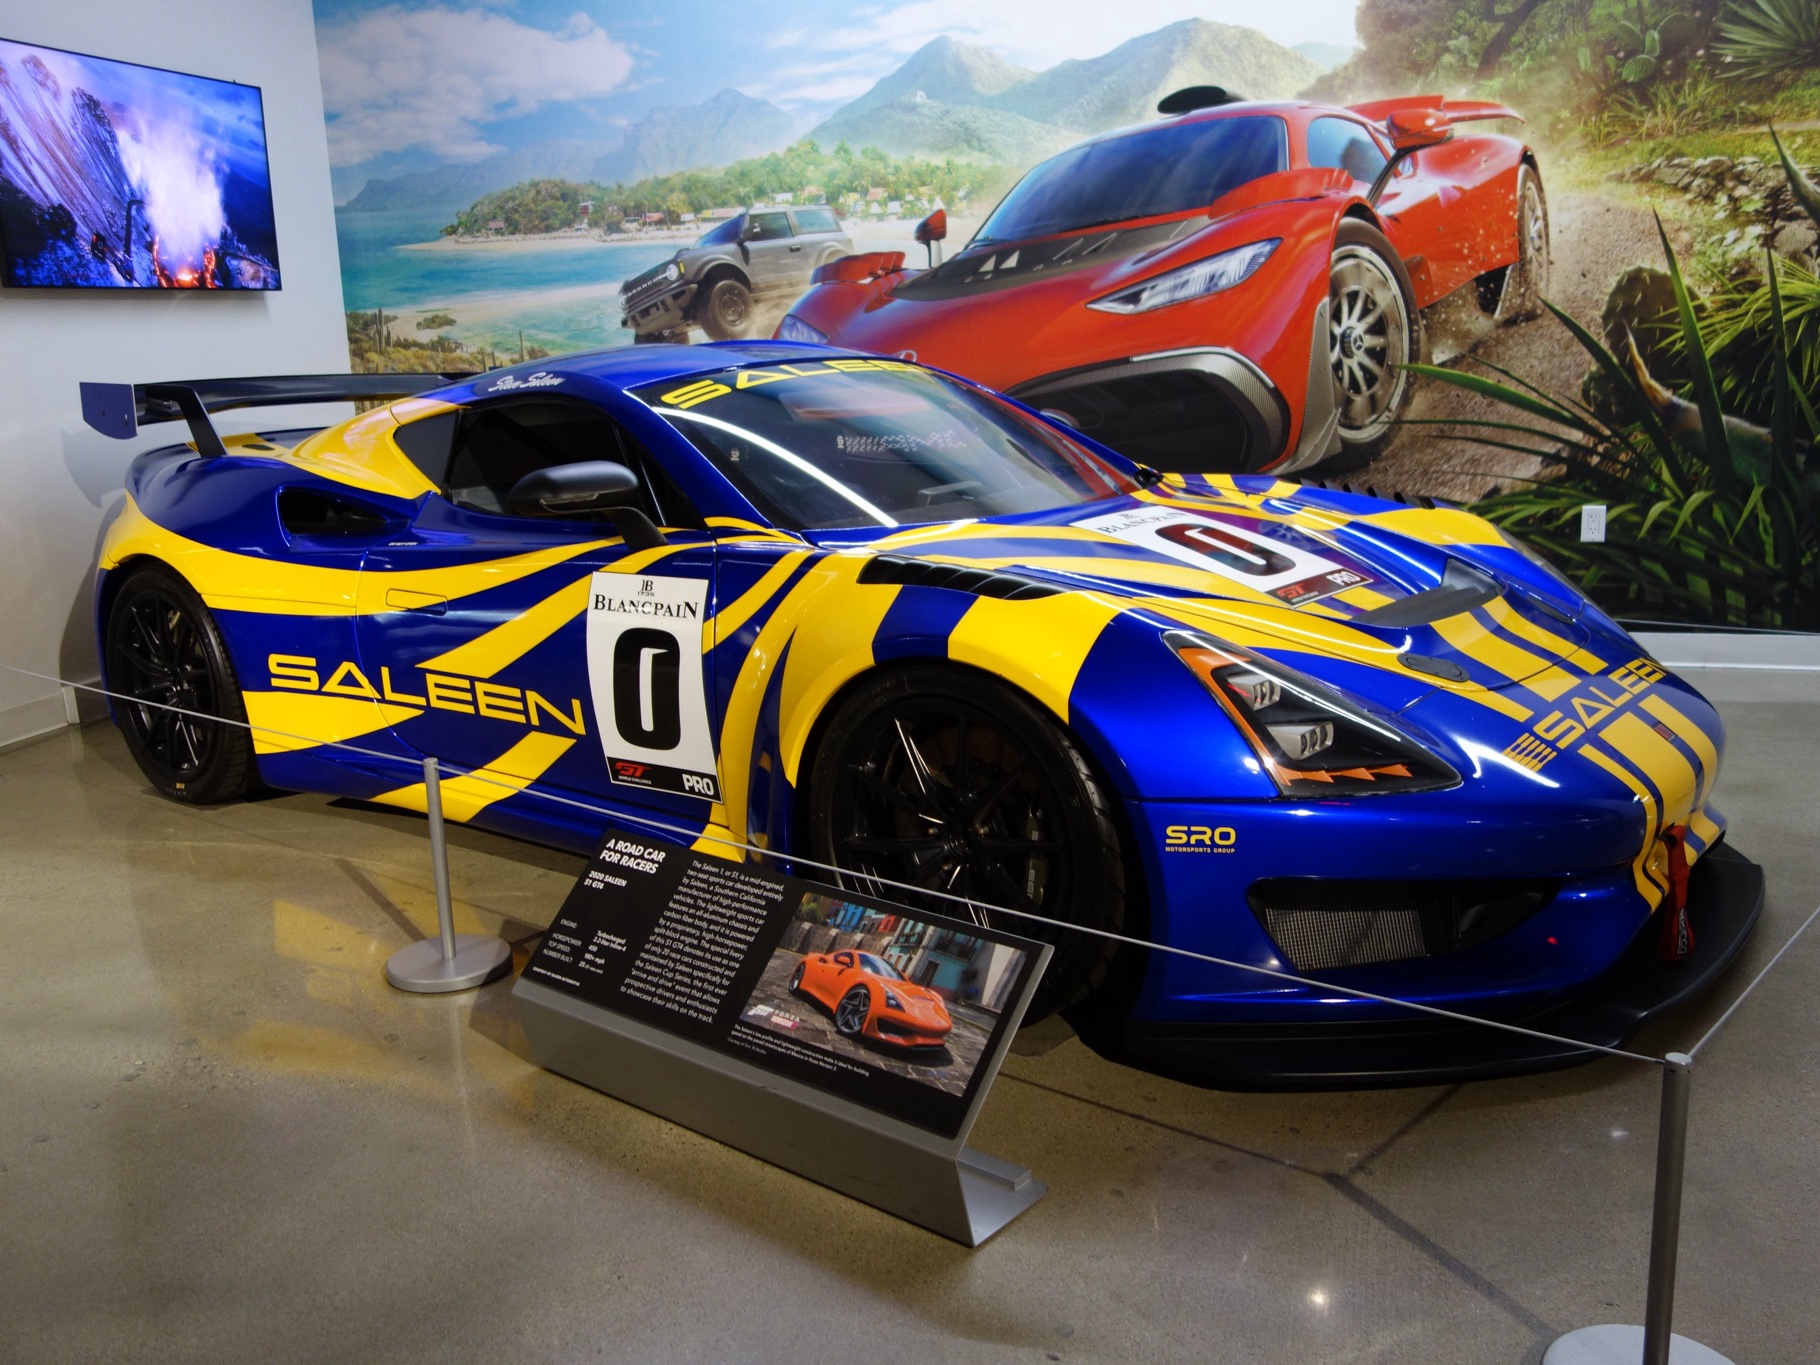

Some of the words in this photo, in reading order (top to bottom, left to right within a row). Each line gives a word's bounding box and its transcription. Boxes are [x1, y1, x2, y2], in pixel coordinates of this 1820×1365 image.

[1154, 523, 1297, 577] 0
[1326, 571, 1361, 586] PRO
[593, 594, 699, 619] BLANCPAIN
[268, 653, 587, 736] SALEEN
[613, 628, 681, 751] 0
[682, 773, 715, 796] PRO
[1165, 825, 1236, 846] SRO
[600, 850, 621, 864] FOR
[620, 855, 659, 874] RACERS
[606, 839, 616, 849] A
[615, 841, 644, 856] ROAD
[644, 848, 666, 863] CAR
[589, 871, 605, 880] 2020
[604, 875, 627, 887] SALEEN
[692, 860, 702, 869] The
[702, 863, 719, 873] Saleen
[584, 878, 593, 886] S1
[592, 881, 605, 890] GT4
[682, 876, 690, 885] by
[714, 885, 739, 898] Southern
[739, 893, 766, 906] California
[687, 869, 709, 880] two-seat
[709, 876, 726, 885] sports
[734, 882, 764, 895] developed
[763, 891, 784, 902] entirely
[678, 886, 713, 899] manufacturer
[719, 896, 767, 916] high-performance
[697, 899, 707, 908] The
[707, 902, 737, 917] lightweight
[737, 913, 755, 922] sports
[659, 917, 666, 926] by
[664, 911, 682, 920] carbon
[682, 914, 695, 923] fiber
[729, 931, 755, 942] powered
[669, 901, 689, 913] features
[696, 910, 729, 924] all-aluminum
[729, 920, 748, 930] chassis
[748, 926, 760, 934] and
[654, 927, 680, 939] split-block
[700, 940, 710, 949] The
[710, 945, 730, 955] special
[729, 949, 745, 961] livery
[655, 937, 665, 945] this
[672, 941, 684, 950] GT4
[683, 945, 704, 957] denotes
[704, 952, 712, 960] its
[729, 961, 740, 969] one
[640, 952, 669, 966] maintained
[668, 960, 675, 969] by
[675, 962, 693, 974] Saleen
[693, 970, 722, 985] specifically
[722, 978, 730, 986] for
[651, 946, 662, 955] only
[662, 948, 670, 956] 20
[669, 952, 681, 960] race
[681, 956, 693, 964] cars
[693, 960, 725, 974] constructed
[724, 970, 736, 978] and
[635, 960, 644, 968] the
[644, 962, 662, 974] Saleen
[662, 969, 674, 979] Cup
[693, 979, 703, 988] the
[703, 982, 715, 992] first
[714, 988, 728, 996] ever
[647, 975, 659, 983] and
[675, 985, 691, 994] event
[691, 989, 703, 998] that
[702, 994, 721, 1005] allows
[624, 978, 656, 992] prospective
[656, 988, 675, 999] drivers
[675, 995, 688, 1003] and
[687, 999, 718, 1014] enthusiasts
[627, 988, 652, 1002] showcase
[652, 997, 666, 1006] their
[665, 1002, 679, 1011] skills
[688, 1009, 698, 1018] the
[774, 1009, 800, 1023] FORZA
